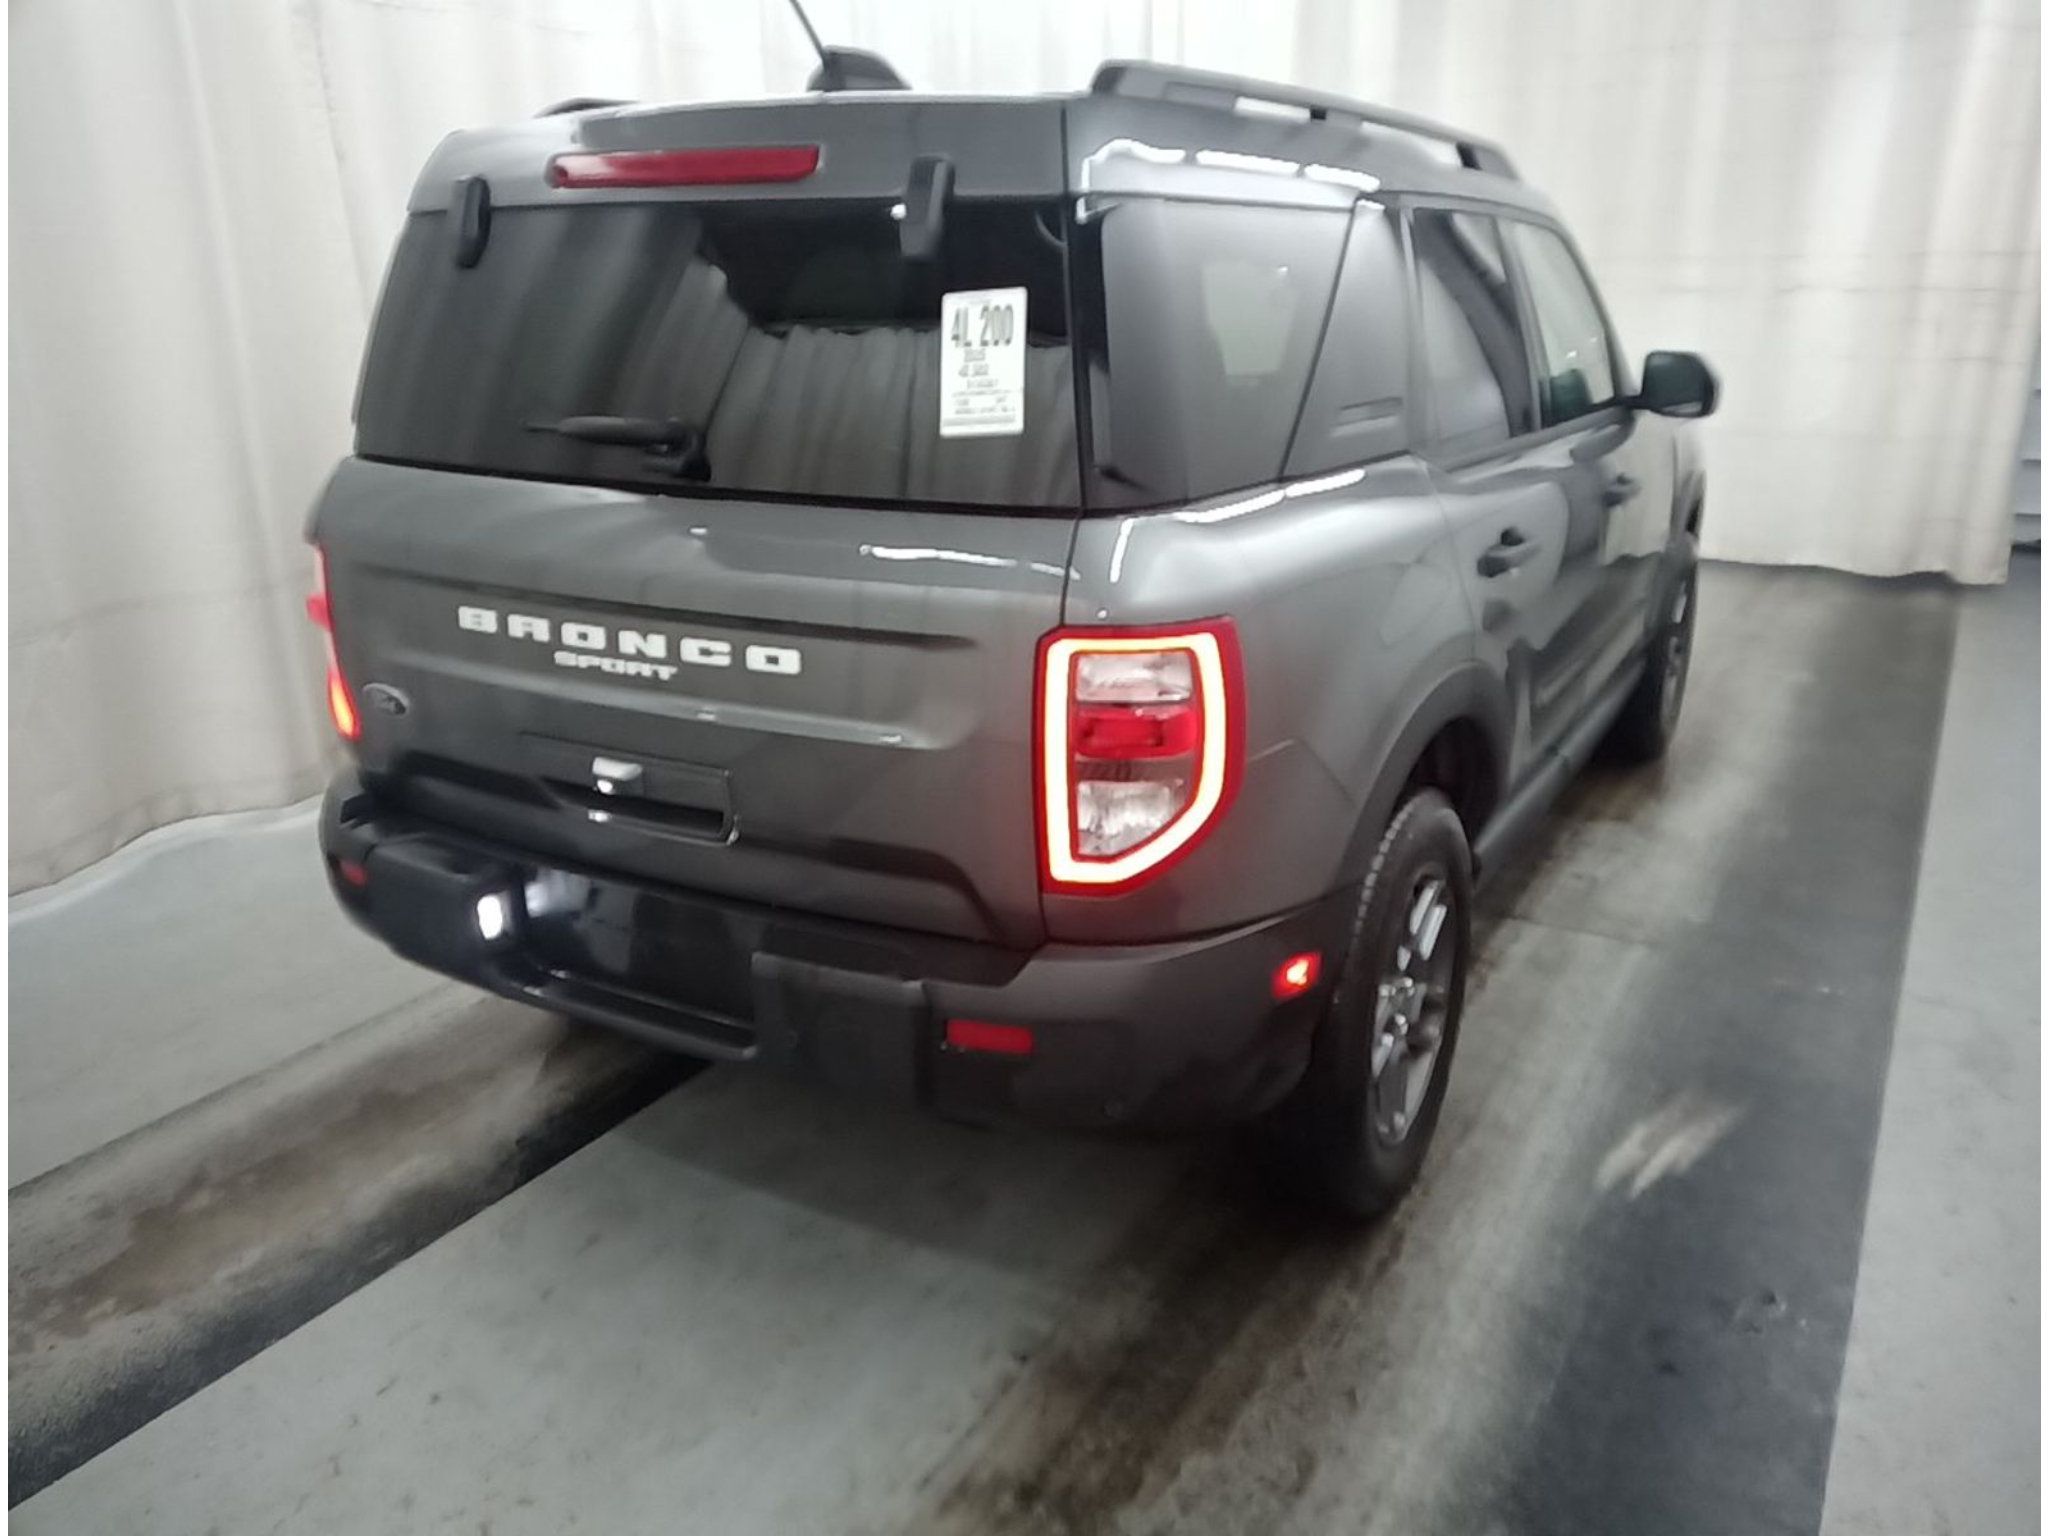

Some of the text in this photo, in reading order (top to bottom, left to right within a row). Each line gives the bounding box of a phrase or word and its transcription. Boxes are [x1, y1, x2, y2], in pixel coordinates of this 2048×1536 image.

[979, 304, 1014, 347] 200
[457, 605, 802, 675] BRONCO
[553, 650, 679, 681] SPORT
